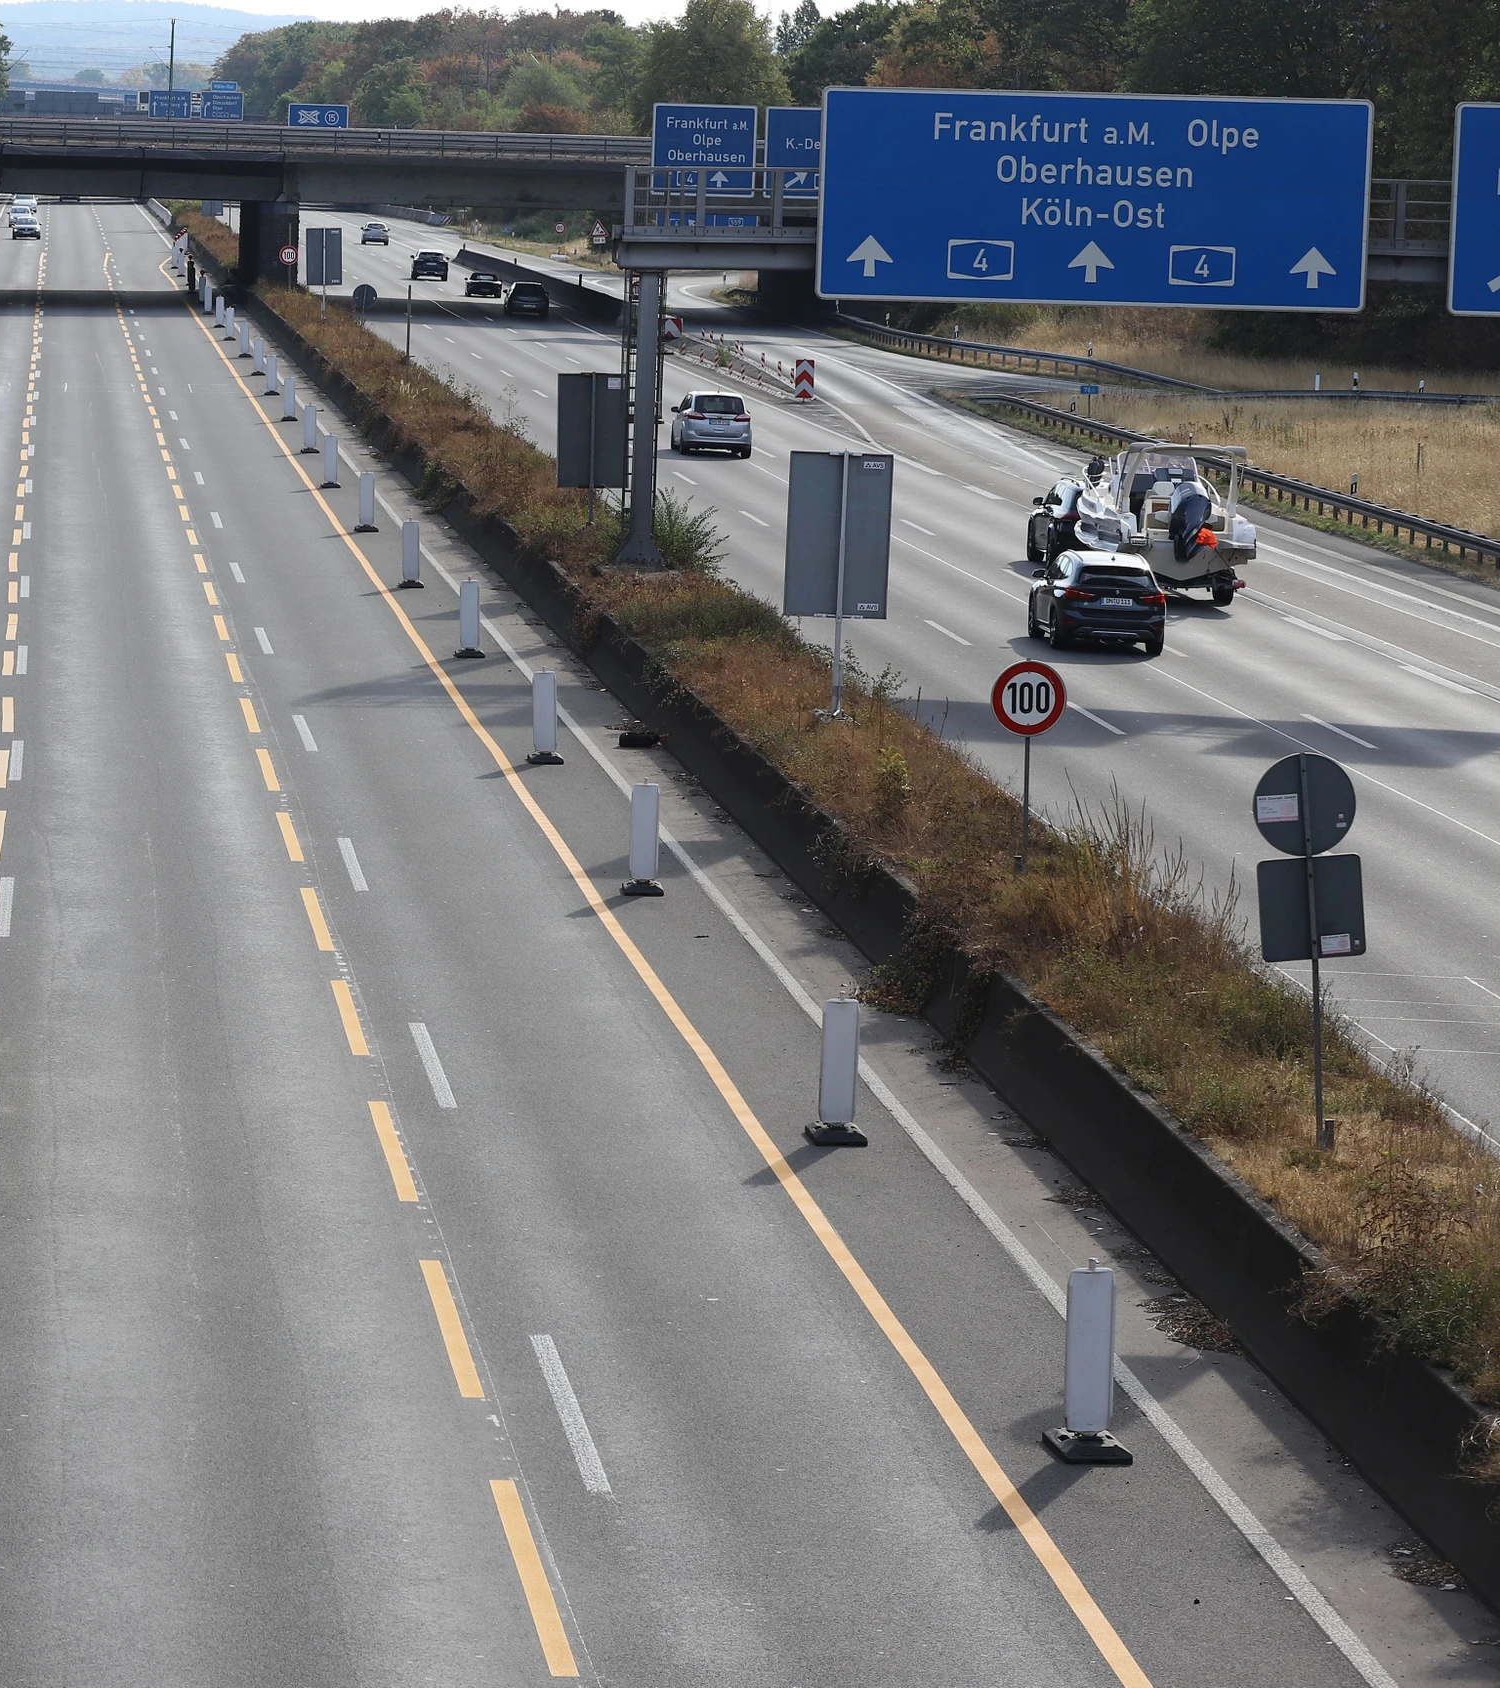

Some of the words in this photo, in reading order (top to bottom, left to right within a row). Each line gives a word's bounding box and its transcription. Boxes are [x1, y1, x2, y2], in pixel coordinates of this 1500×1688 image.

[328, 113, 336, 122] 15
[666, 116, 728, 130] Frankfurt
[732, 120, 749, 131] a.M.
[692, 133, 722, 148] Olpe
[933, 112, 1088, 144] Frankfurt
[1103, 121, 1155, 146] a.M.
[1187, 118, 1260, 155] Olpe
[667, 149, 746, 163] Oberhausen
[686, 173, 693, 183] 4
[996, 154, 1193, 188] Oberhausen
[1021, 197, 1165, 229] Köln-Ost
[283, 251, 295, 260] 100
[972, 248, 988, 272] 4
[1193, 254, 1209, 278] 4
[1007, 681, 1050, 714] 100
